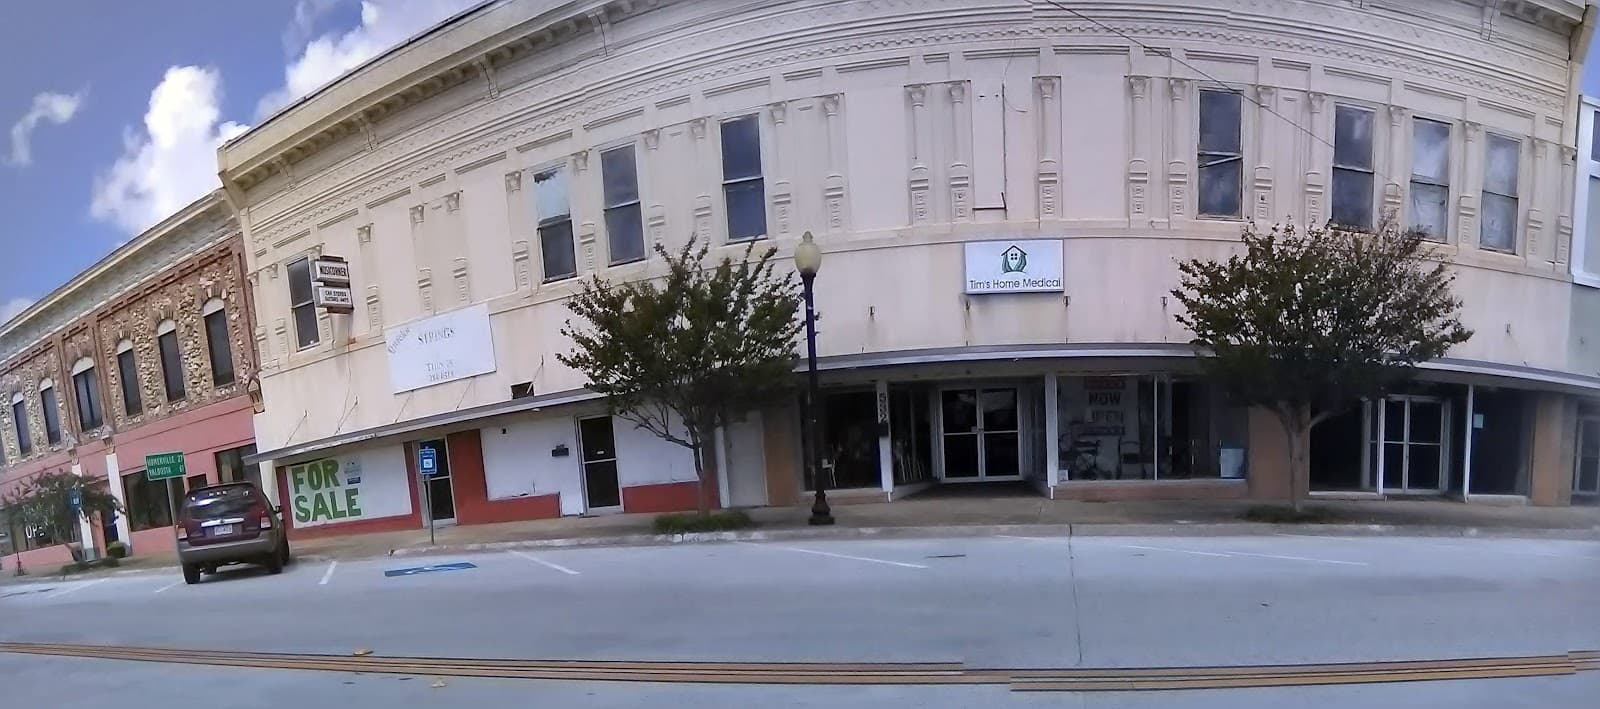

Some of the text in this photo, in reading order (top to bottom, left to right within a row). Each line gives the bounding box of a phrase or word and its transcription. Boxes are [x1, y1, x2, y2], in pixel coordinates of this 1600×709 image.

[969, 278, 1061, 289] Tim's Home Medical
[1088, 391, 1121, 406] NOW
[147, 455, 176, 466] HOMERVILLE
[149, 466, 172, 476] VALDOSTA
[291, 459, 340, 494] FOR
[294, 488, 361, 523] SALE
